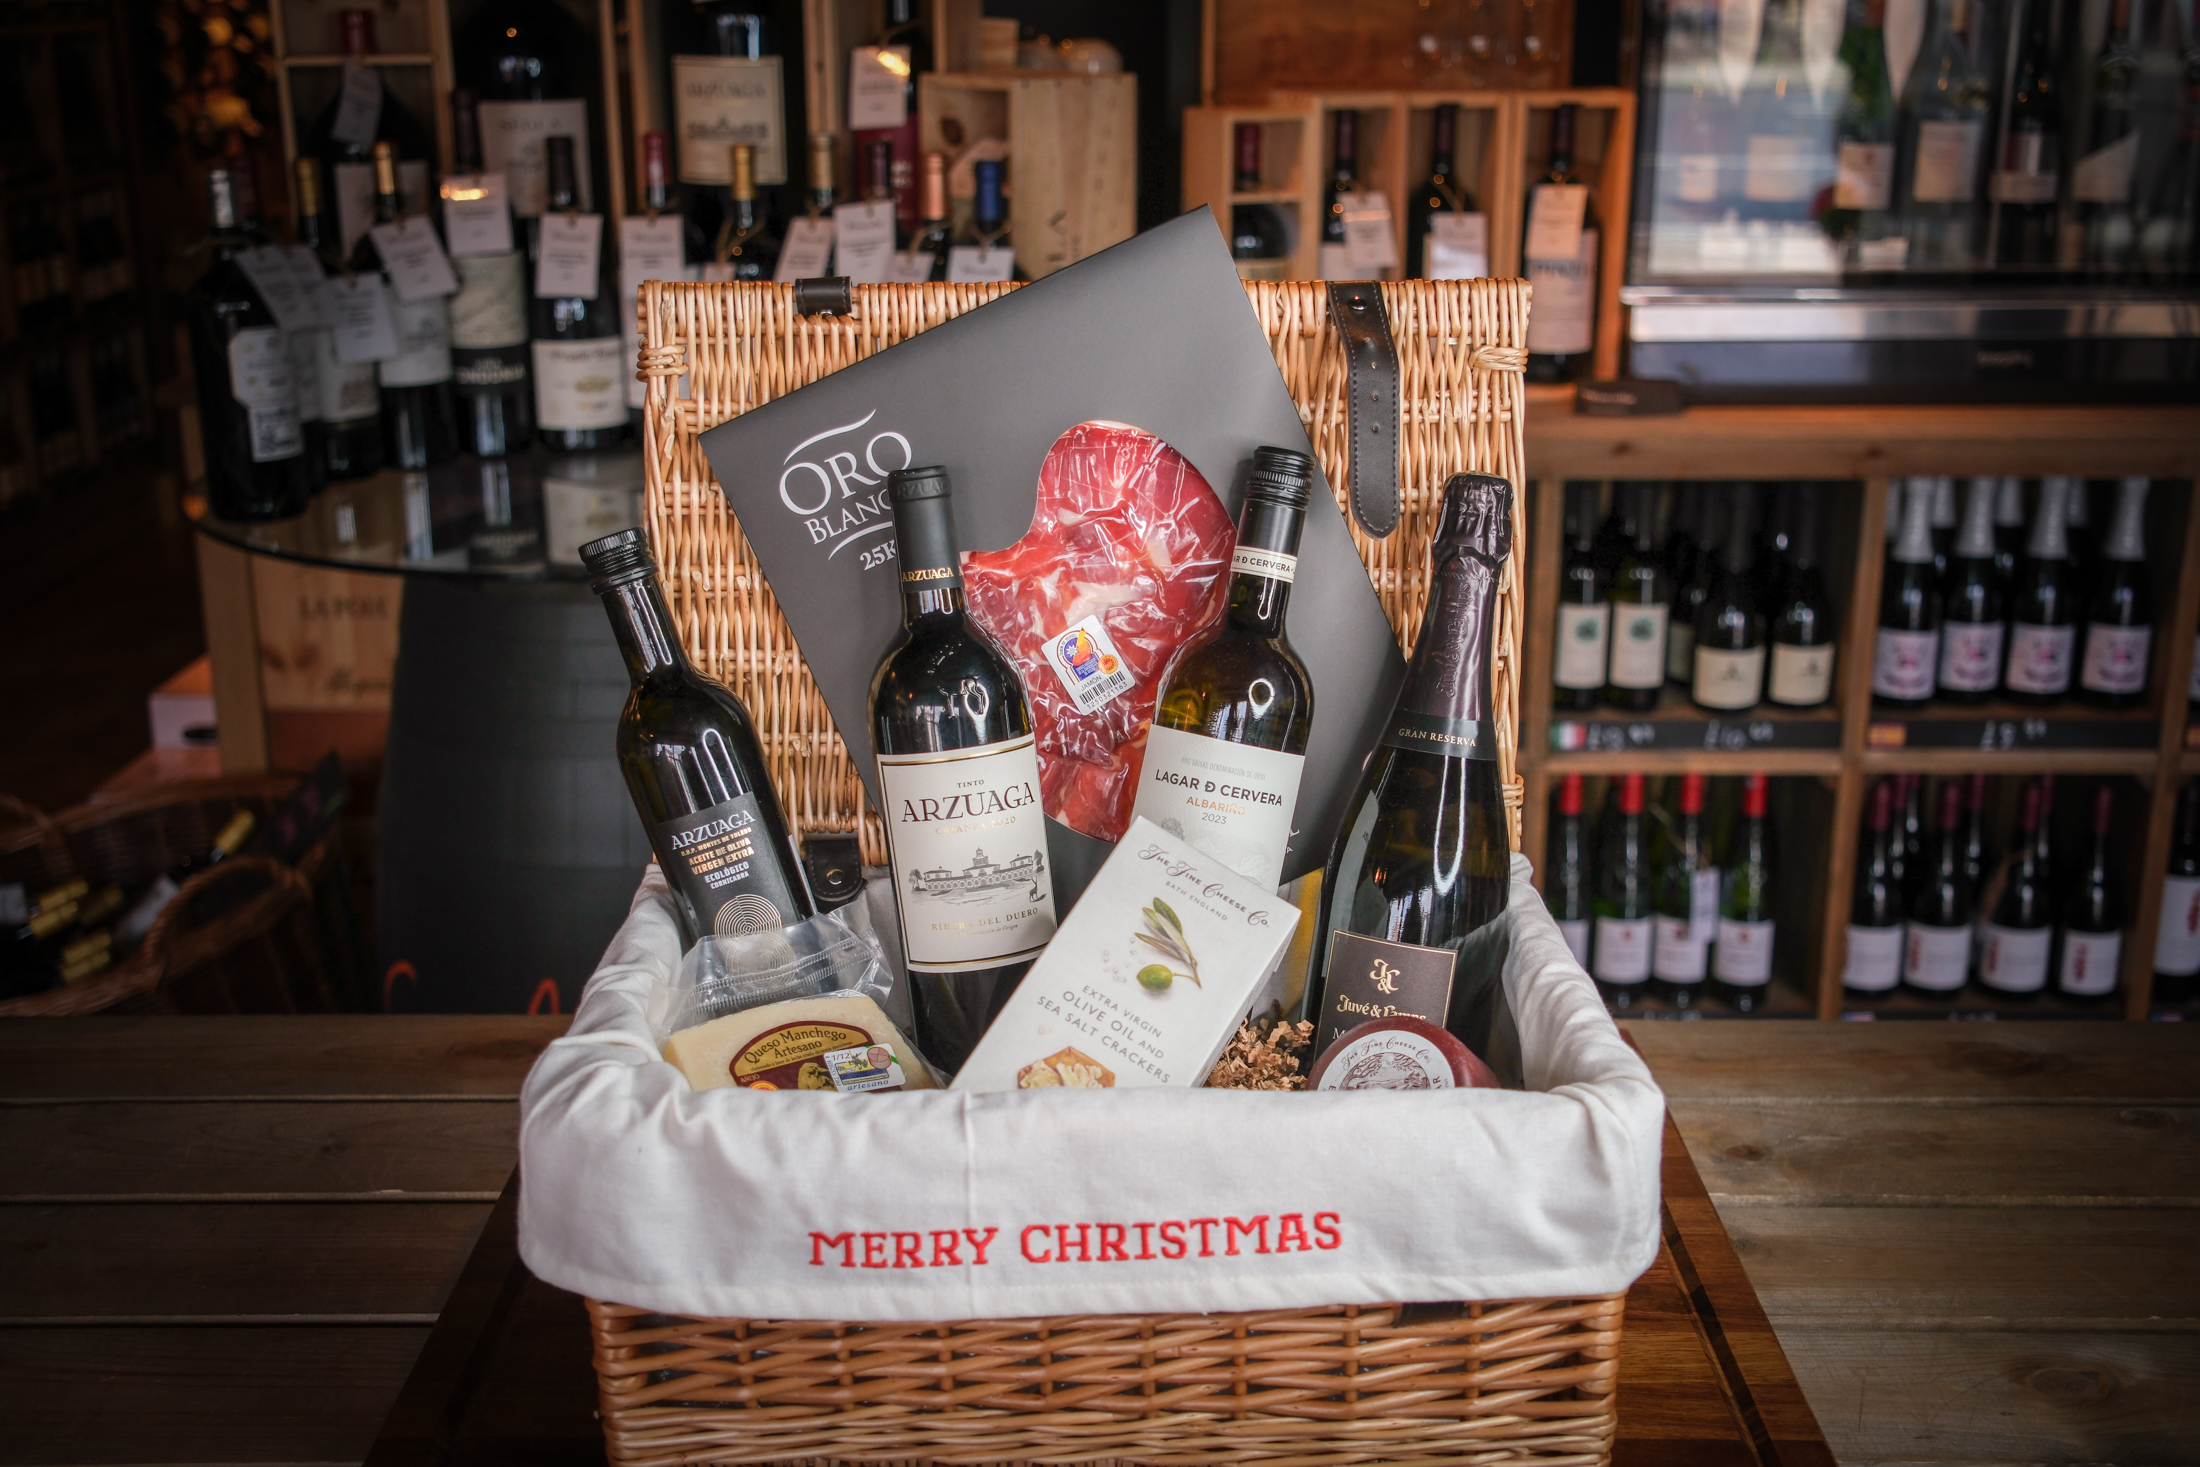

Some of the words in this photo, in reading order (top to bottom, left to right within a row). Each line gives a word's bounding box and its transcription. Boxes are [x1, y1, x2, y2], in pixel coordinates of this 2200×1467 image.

[779, 431, 912, 516] ORO
[803, 488, 893, 545] BLANC
[902, 567, 955, 582] ARZUAGA
[1249, 557, 1290, 573] CERVERA
[1079, 675, 1102, 692] JAMÓN
[1398, 727, 1427, 739] GRAN
[1429, 732, 1477, 747] RESERVA
[957, 779, 985, 788] TINTO
[1155, 768, 1200, 791] LAGAR
[1220, 784, 1283, 807] CERVERA
[902, 782, 1036, 823] ARZUAGA
[1186, 796, 1246, 816] ALBARIÑO
[672, 809, 756, 850] ARZUAGA
[935, 822, 987, 836] CRIANZA
[991, 815, 1017, 828] 2020
[1201, 812, 1227, 825] 2023
[731, 826, 752, 840] TOLEDO
[688, 850, 715, 866] ACEITE
[716, 847, 727, 857] DE
[726, 837, 752, 853] OLIVA
[691, 857, 725, 875] VIRGEN
[726, 846, 755, 865] EXTRA
[704, 860, 750, 884] ECOLÓGICO
[1165, 880, 1187, 896] BATH
[1189, 894, 1228, 921] ENGLAND
[931, 922, 974, 931] RIBERA
[979, 916, 1002, 927] DEL
[1006, 907, 1039, 922] DUERO
[1082, 985, 1119, 1012] EXTRA
[1123, 1009, 1162, 1038] VIRGIN
[1336, 994, 1370, 1015] Juvé
[1370, 1004, 1381, 1018] &
[1062, 990, 1107, 1022] OLIVE
[1110, 1020, 1134, 1042] OIL
[1138, 1039, 1164, 1059] AND
[744, 1039, 781, 1064] Queso
[779, 1026, 847, 1044] Manchego
[774, 1040, 822, 1059] Artesano
[1037, 995, 1061, 1016] SEA
[1065, 1012, 1099, 1037] SALT
[1101, 1035, 1171, 1083] CRACKERS
[831, 1053, 850, 1061] 1/12
[847, 1080, 889, 1091] artesano
[808, 1227, 999, 1269] MERRY
[1019, 1211, 1343, 1264] CHRISTMAS
